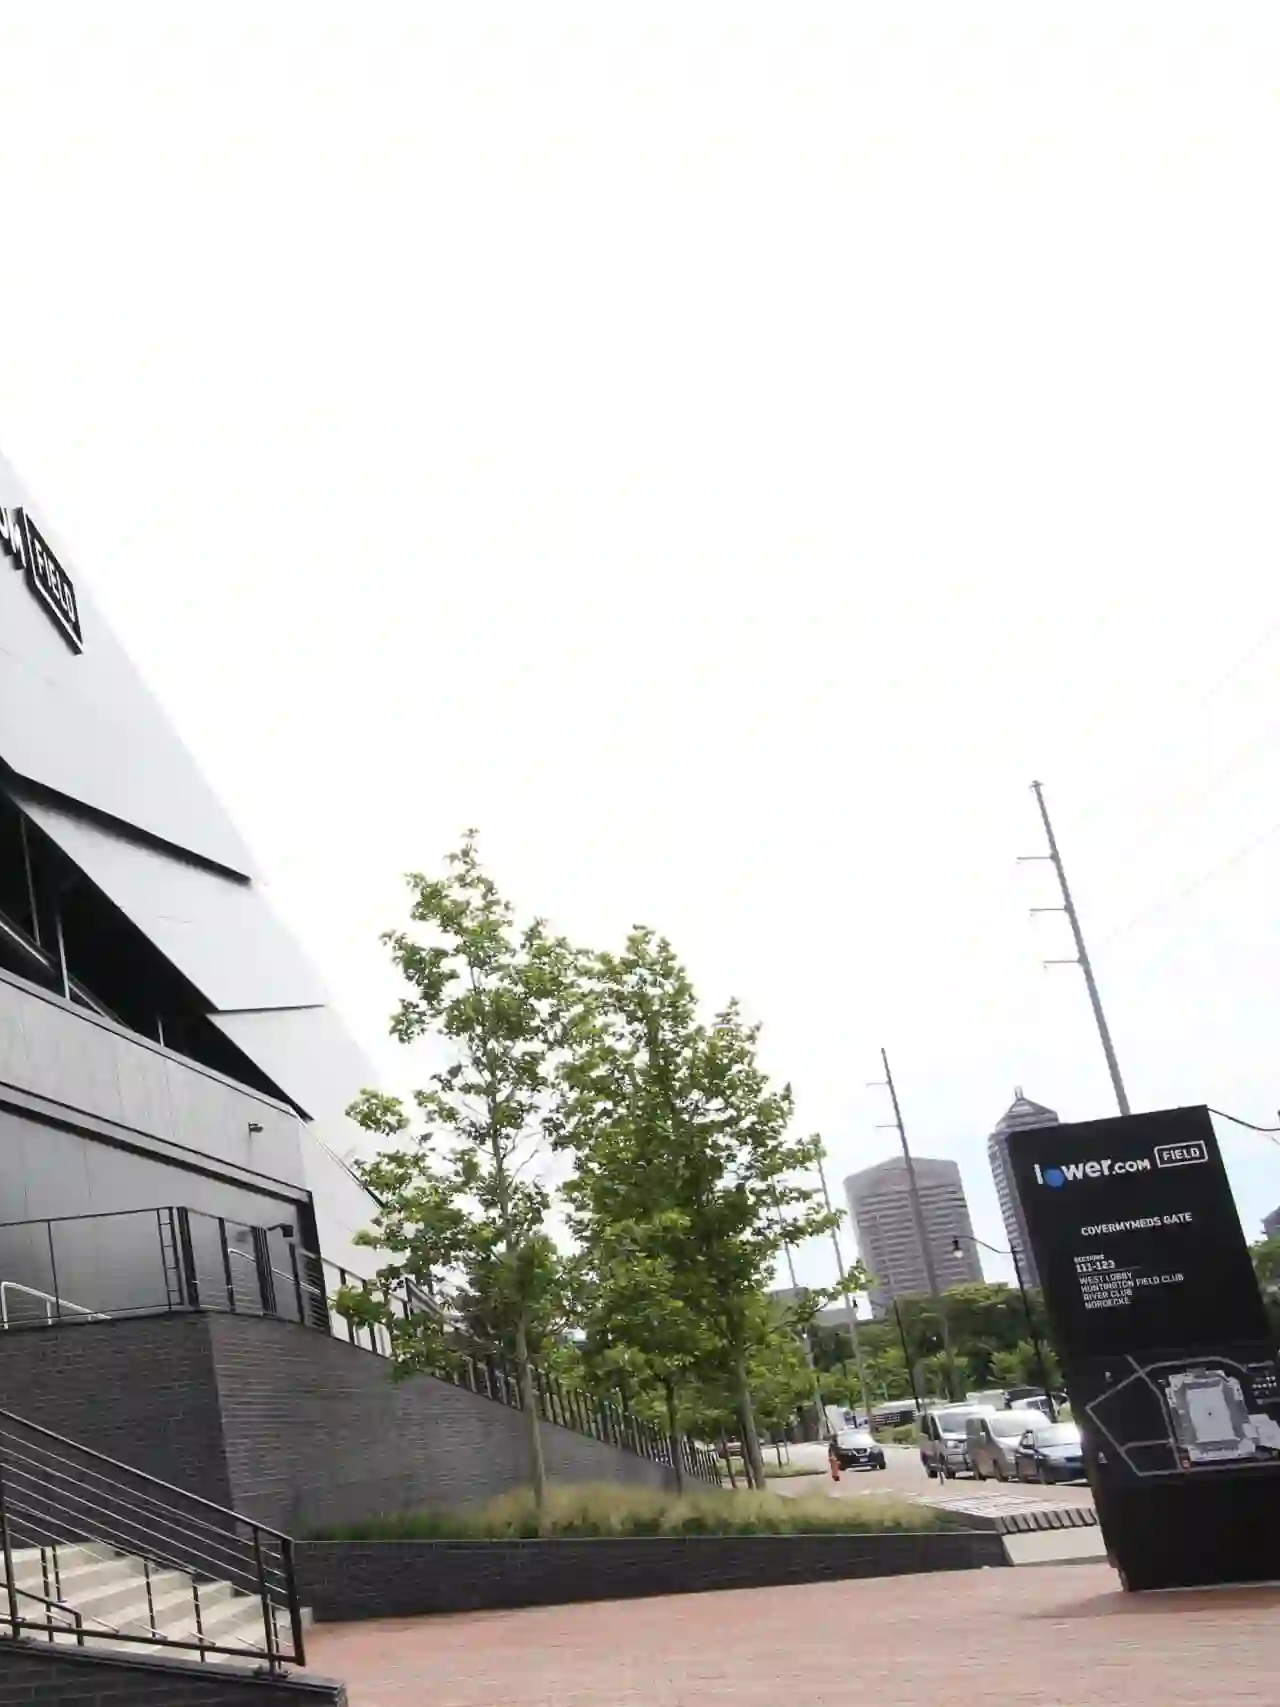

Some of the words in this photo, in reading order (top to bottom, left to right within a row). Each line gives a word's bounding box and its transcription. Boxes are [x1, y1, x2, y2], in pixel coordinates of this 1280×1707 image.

[33, 537, 76, 623] FIELD
[1162, 1147, 1200, 1161] FIELD
[1163, 1212, 1193, 1225] GATE
[1076, 1260, 1116, 1273] 111-123
[1080, 1275, 1105, 1285] WEST
[1136, 1276, 1160, 1286] FIELD
[1161, 1273, 1184, 1283] CLUB
[1083, 1291, 1109, 1301] RIVER
[1110, 1288, 1133, 1298] CLUB
